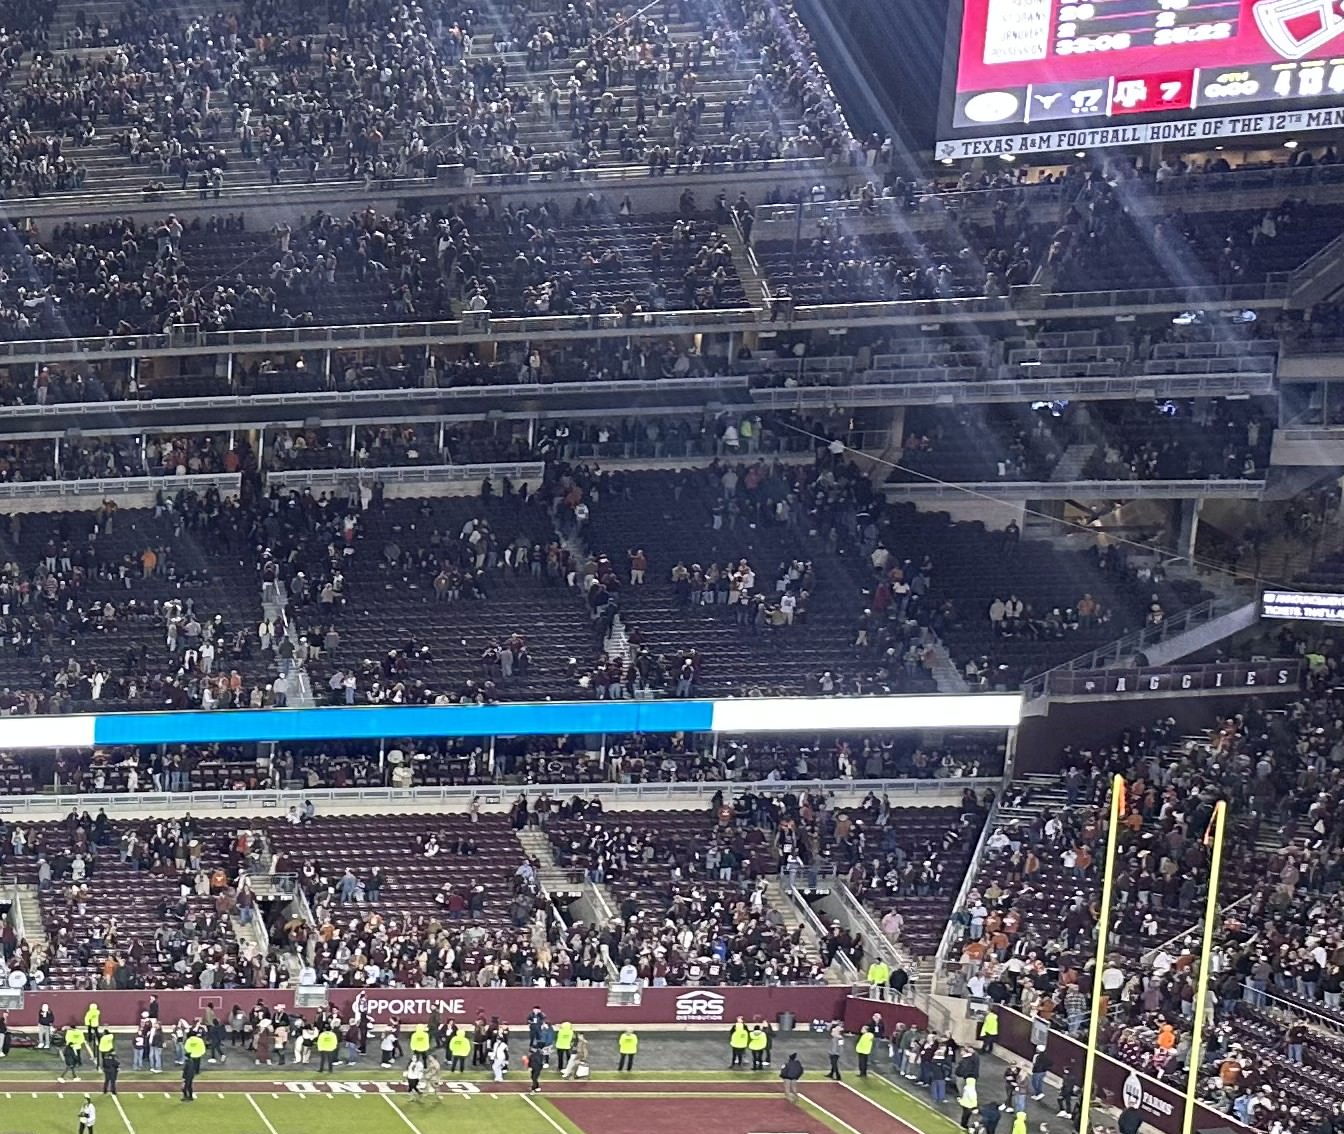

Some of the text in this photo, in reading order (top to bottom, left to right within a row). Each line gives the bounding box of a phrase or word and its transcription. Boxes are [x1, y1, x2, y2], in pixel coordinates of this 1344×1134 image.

[1070, 88, 1103, 108] 17
[1160, 81, 1182, 101] 7
[961, 138, 1014, 156] TEXAS
[1017, 135, 1052, 152] A&M
[1057, 127, 1142, 150] FOOTBALL
[1149, 123, 1196, 141] HOME
[1202, 120, 1223, 136] OF
[1227, 116, 1263, 134] THE
[1306, 109, 1344, 128] MAN
[1115, 670, 1290, 693] AGGIES
[676, 999, 725, 1015] SRS
[1142, 1091, 1175, 1116] FARMS
